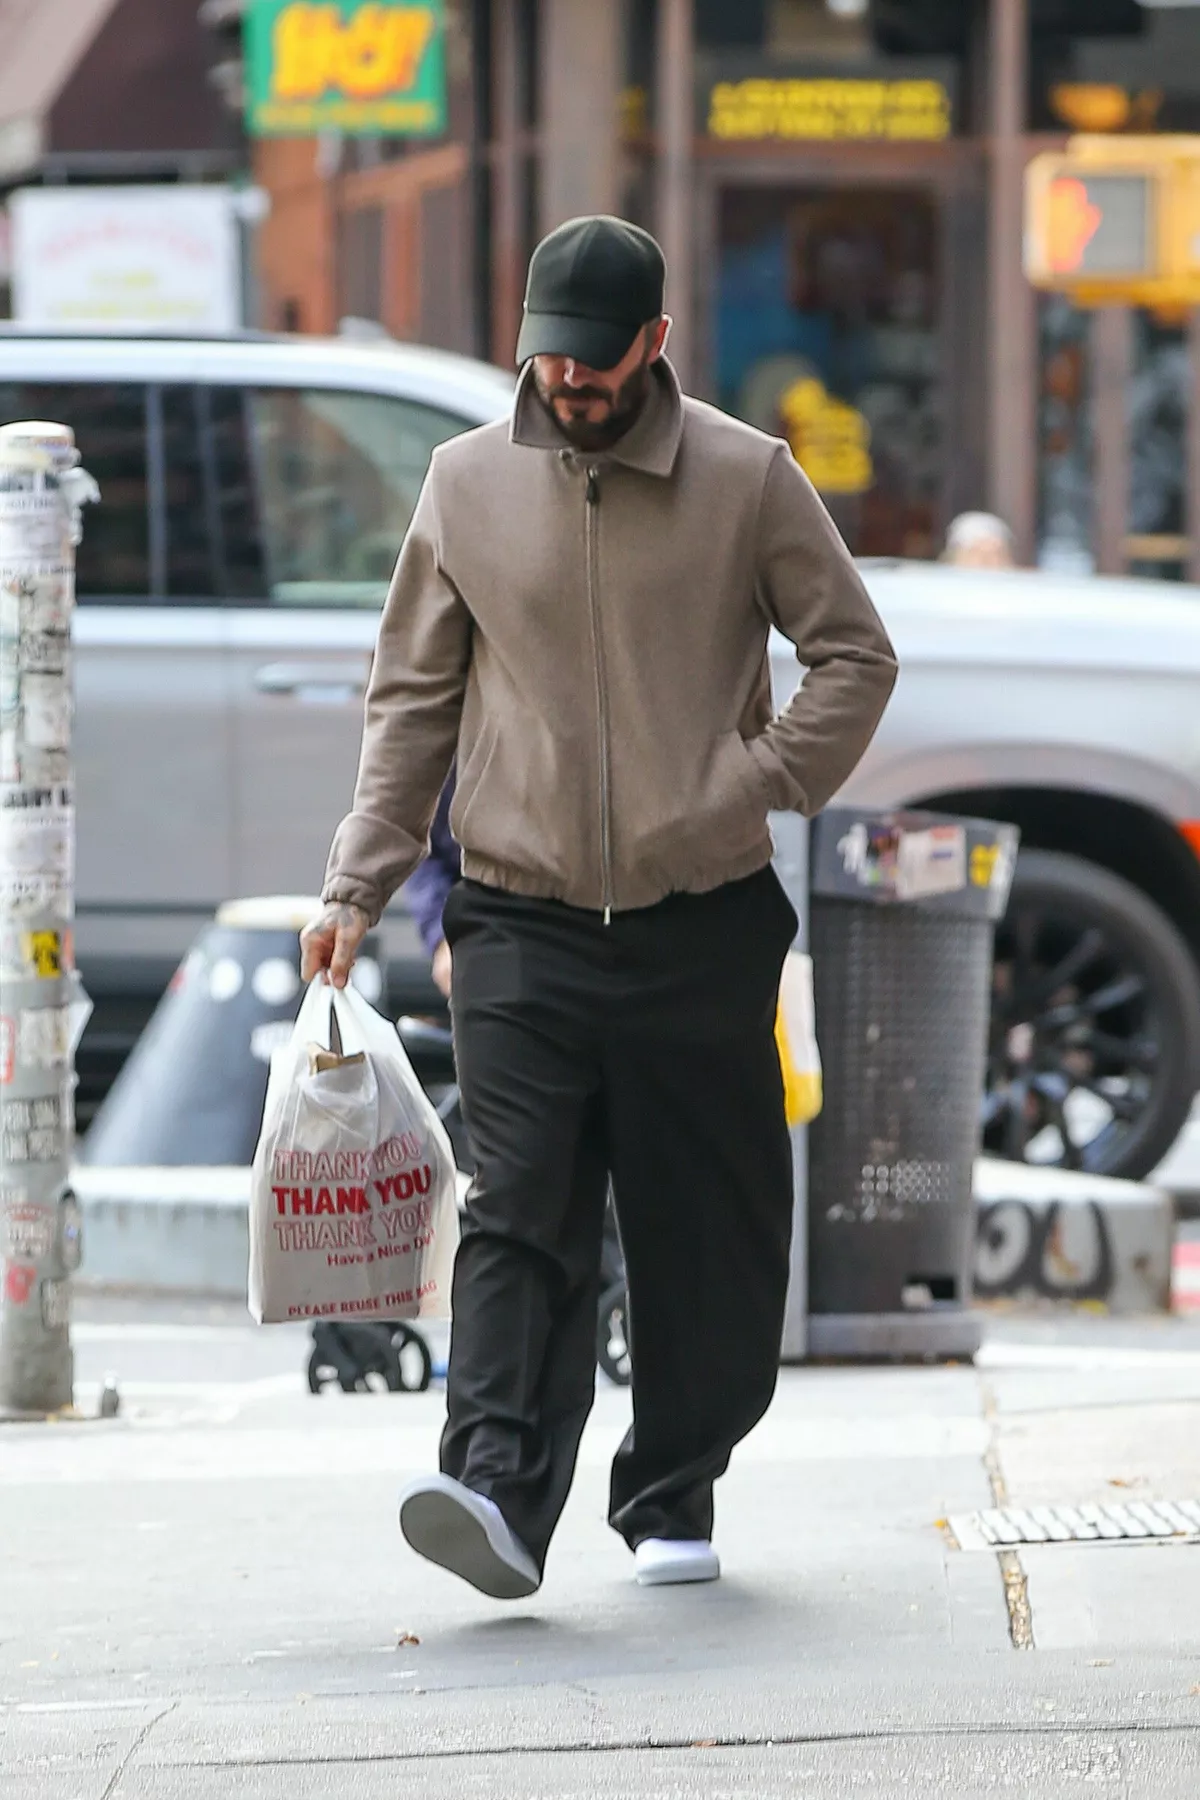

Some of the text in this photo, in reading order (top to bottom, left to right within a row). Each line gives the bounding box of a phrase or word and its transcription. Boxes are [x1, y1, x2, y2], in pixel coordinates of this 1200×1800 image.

[274, 1131, 422, 1182] THANK YOU
[271, 1163, 431, 1215] THANK YOU
[273, 1199, 432, 1251] THANK YOU
[327, 1253, 364, 1267] Have
[378, 1243, 411, 1259] Nice
[288, 1301, 336, 1316] PLEASE
[340, 1297, 380, 1312] REUSE
[385, 1290, 413, 1307] THIS
